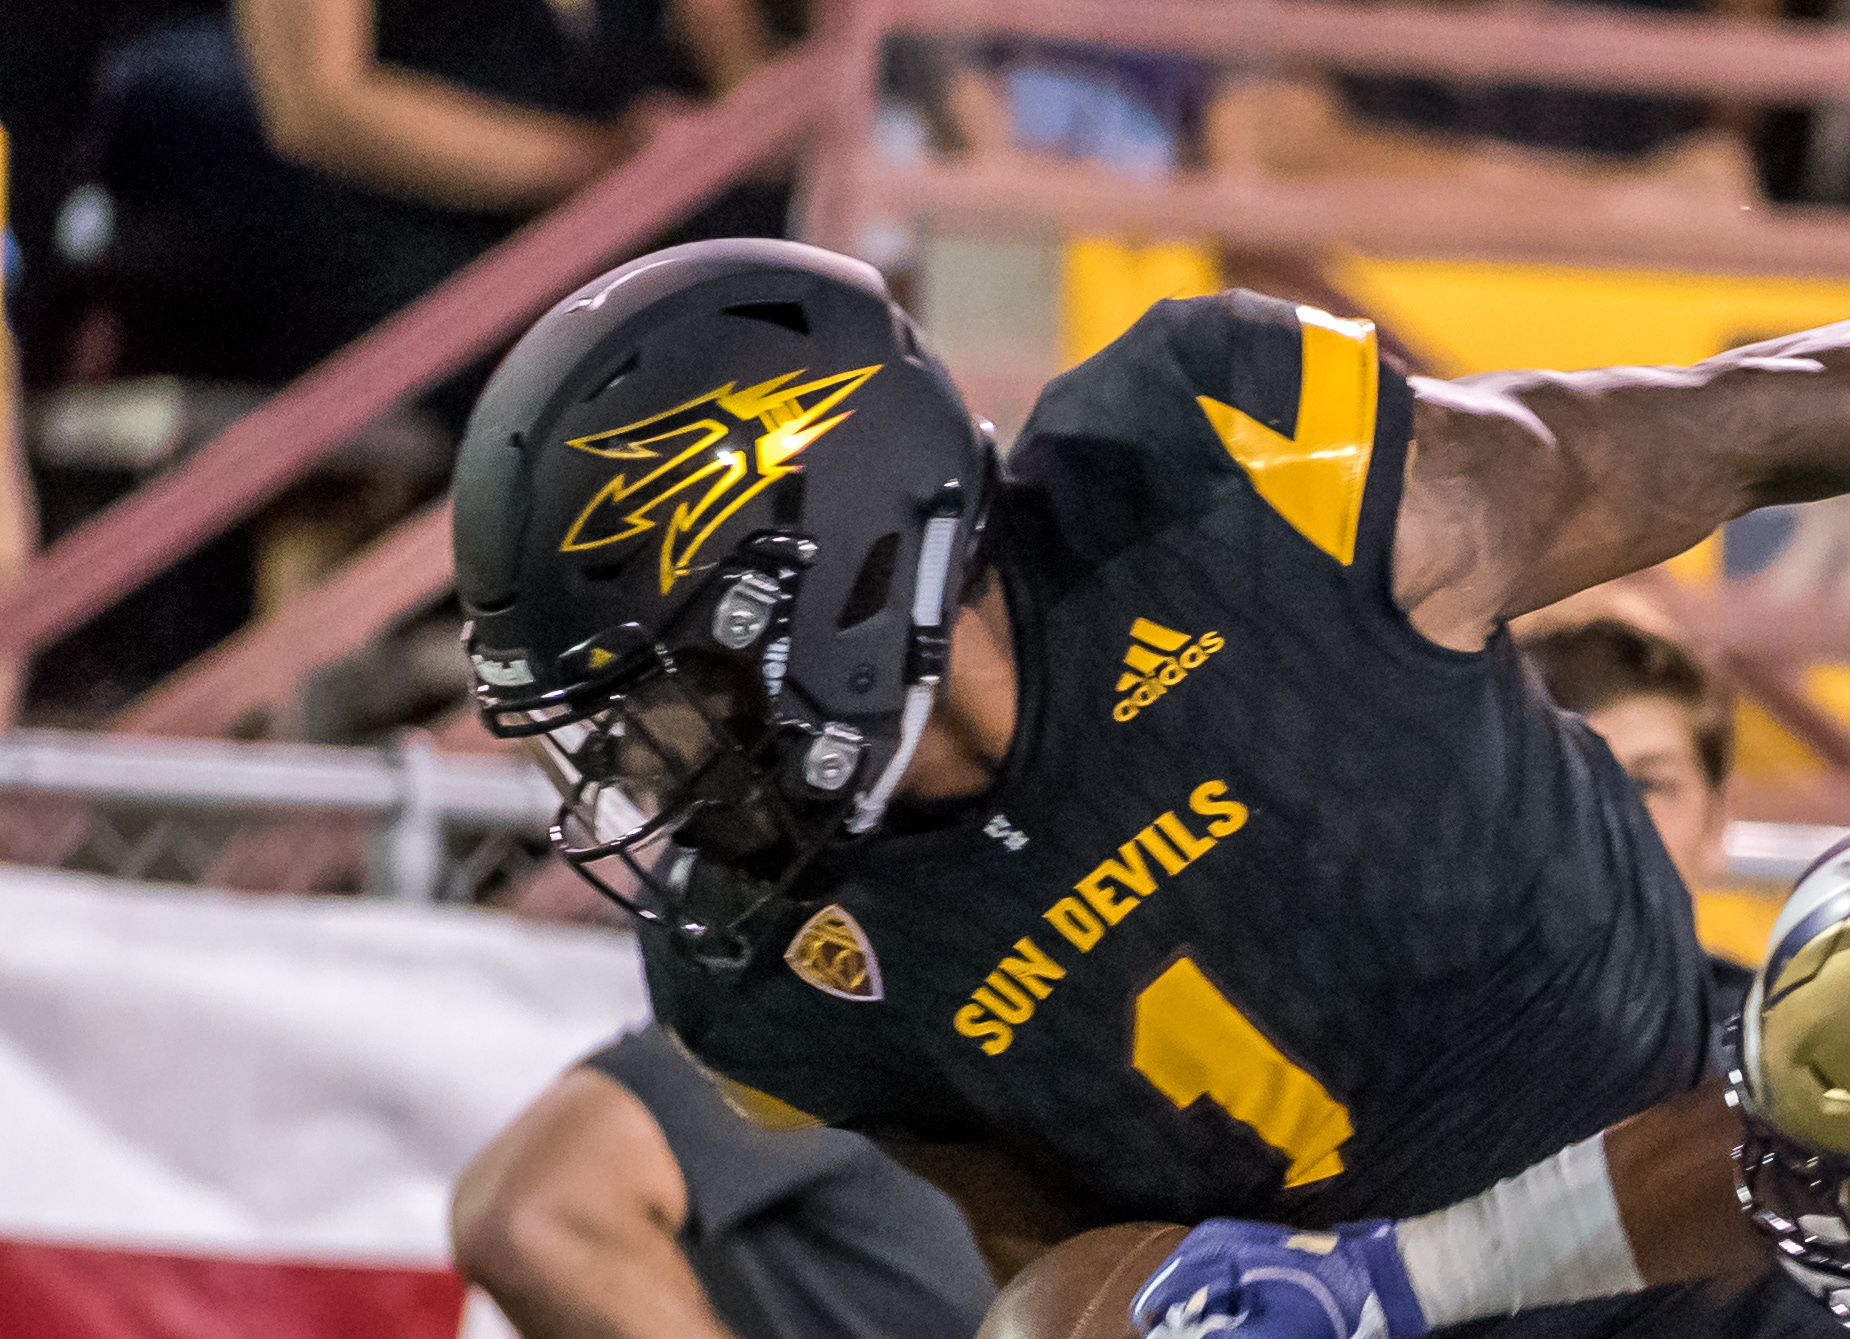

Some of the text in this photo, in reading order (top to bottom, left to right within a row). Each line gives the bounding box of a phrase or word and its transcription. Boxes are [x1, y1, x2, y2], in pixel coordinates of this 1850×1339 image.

[1113, 631, 1225, 722] adidas
[954, 936, 1067, 1056] SUN
[1042, 779, 1249, 953] DEVILS
[1133, 957, 1354, 1188] 1
